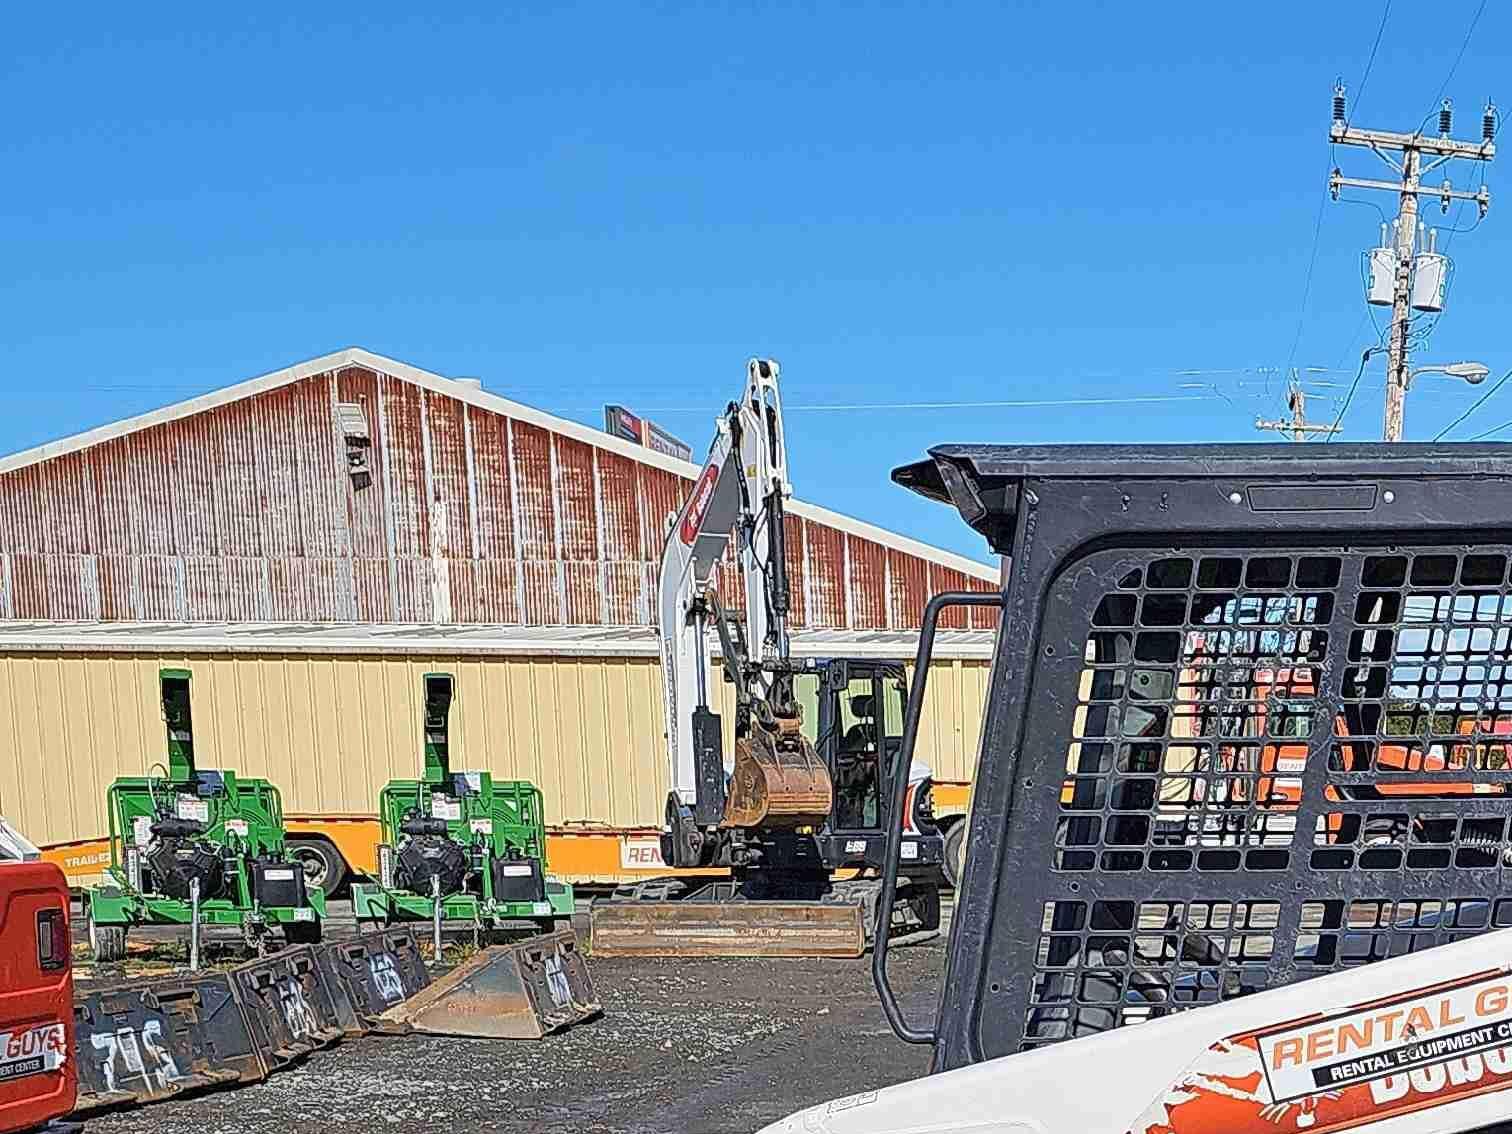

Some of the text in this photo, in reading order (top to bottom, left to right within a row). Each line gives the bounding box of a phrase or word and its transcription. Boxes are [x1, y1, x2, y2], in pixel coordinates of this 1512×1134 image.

[7, 1026, 61, 1058] GUYS
[1272, 999, 1466, 1071] RENTAL
[1330, 1056, 1396, 1082] RENTAL
[1397, 1026, 1494, 1065] EQUIPMENT
